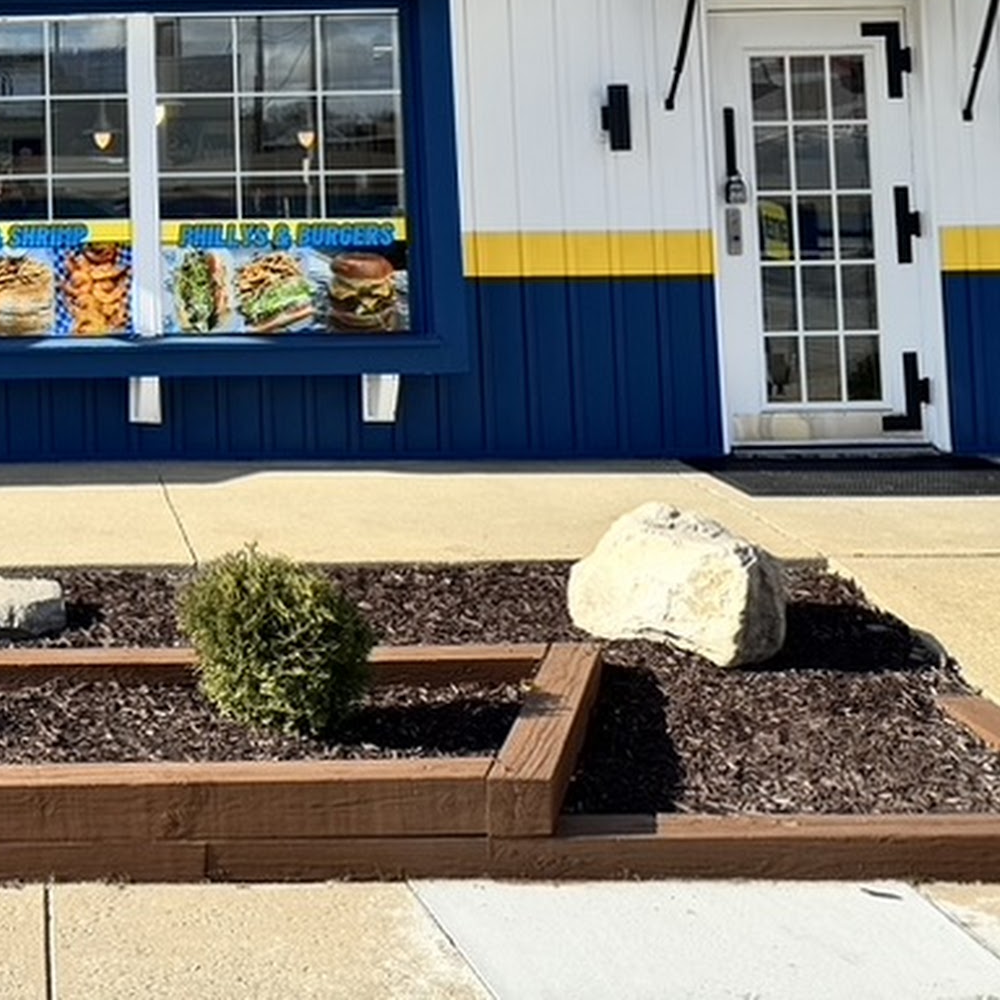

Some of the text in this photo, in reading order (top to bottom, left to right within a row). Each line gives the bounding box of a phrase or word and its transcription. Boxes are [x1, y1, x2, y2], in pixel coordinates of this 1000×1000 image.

[7, 224, 88, 248] SHRIMP
[179, 222, 395, 250] PHILLYS & BURGERS
